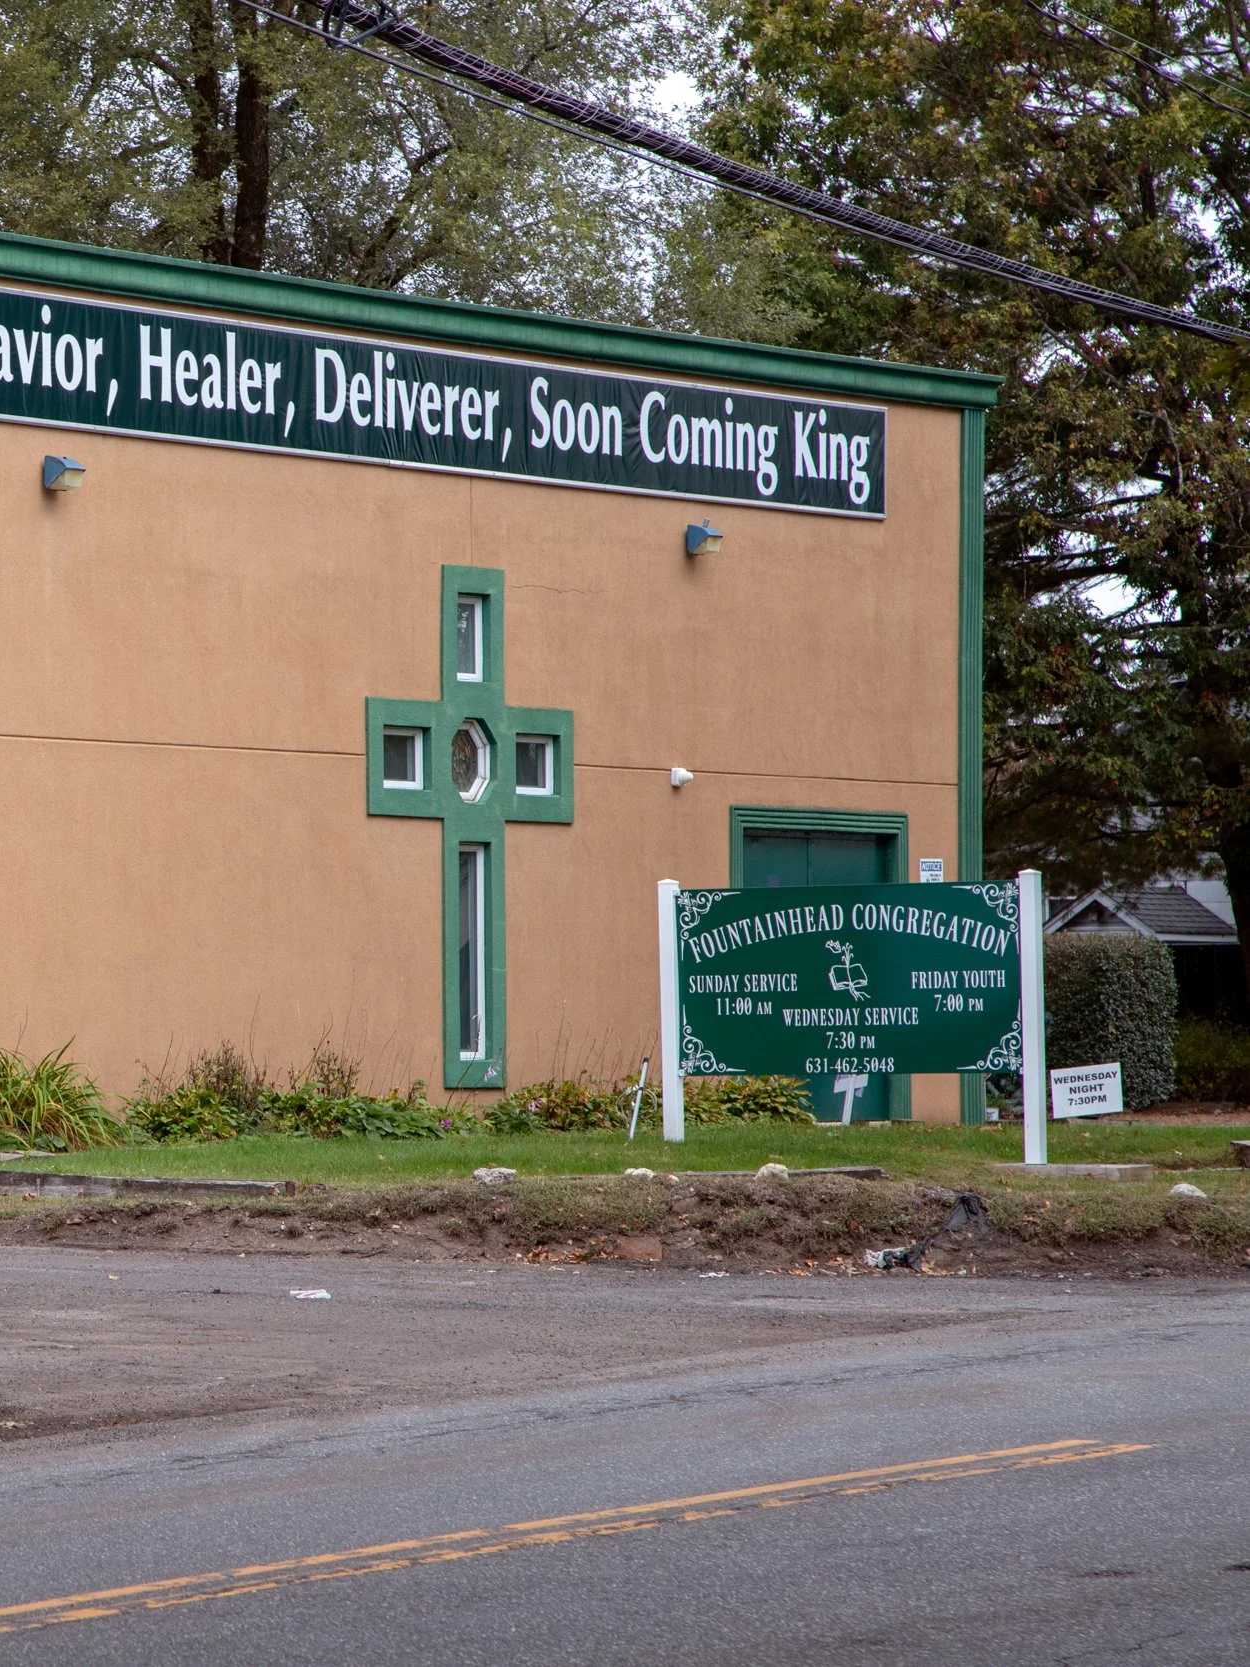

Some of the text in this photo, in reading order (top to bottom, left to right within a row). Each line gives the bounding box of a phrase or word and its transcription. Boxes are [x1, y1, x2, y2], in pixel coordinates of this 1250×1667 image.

[140, 323, 296, 439] Healer,
[314, 347, 513, 464] Deliverer,
[530, 375, 623, 458] Soon
[639, 390, 780, 497] Coming
[793, 407, 871, 506] King
[921, 862, 942, 871] NOTICE
[688, 903, 1012, 963] FOUNTAINHEAD CONGREGATION
[688, 973, 798, 994] SUNDAY SERVICE
[911, 969, 1006, 989] FRIDAY YOUTH
[716, 997, 773, 1016] 11:00 AM
[933, 993, 984, 1012] 7:00 PM
[782, 1006, 919, 1027] WEDNESDAY SERVICE
[826, 1031, 876, 1049] 7:30 PM
[805, 1057, 895, 1074] 631-462-5048
[1053, 1071, 1118, 1085] WEDNESDAY
[1069, 1083, 1104, 1095] NIGHT
[1067, 1094, 1107, 1106] 7:30PM
